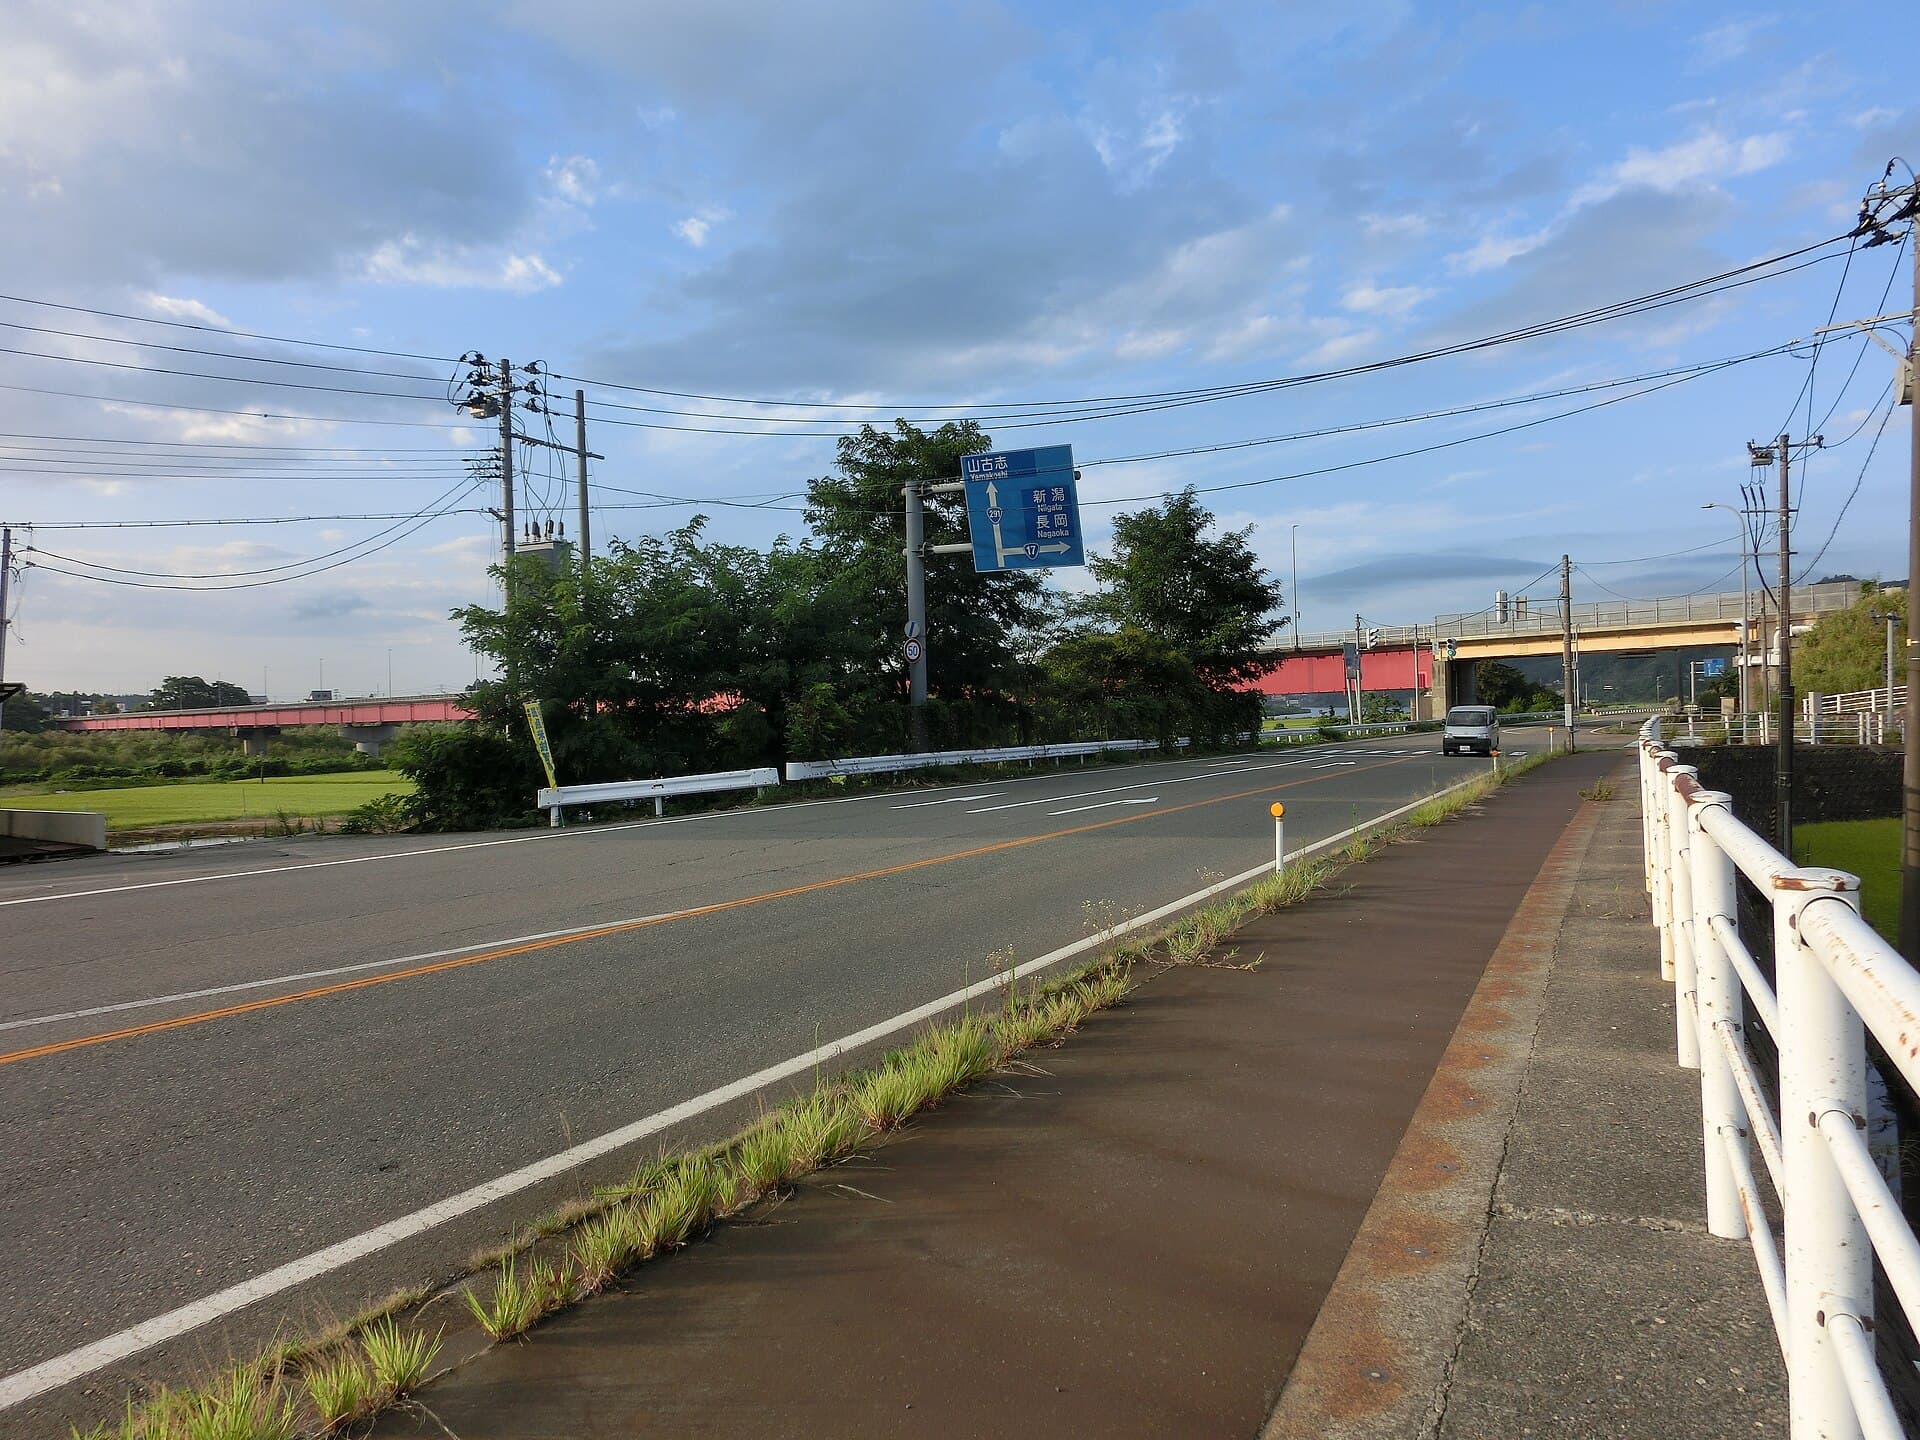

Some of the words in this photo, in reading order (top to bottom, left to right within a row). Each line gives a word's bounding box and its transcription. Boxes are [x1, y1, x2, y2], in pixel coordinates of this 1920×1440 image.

[968, 456, 1008, 472] 山古志
[1032, 487, 1065, 503] 新潟
[1037, 503, 1063, 512] Niigata
[989, 510, 1000, 518] 291
[1036, 513, 1068, 529] 長岡
[1037, 529, 1069, 538] Nagaoka
[1025, 545, 1036, 555] 17
[908, 645, 918, 656] 50
